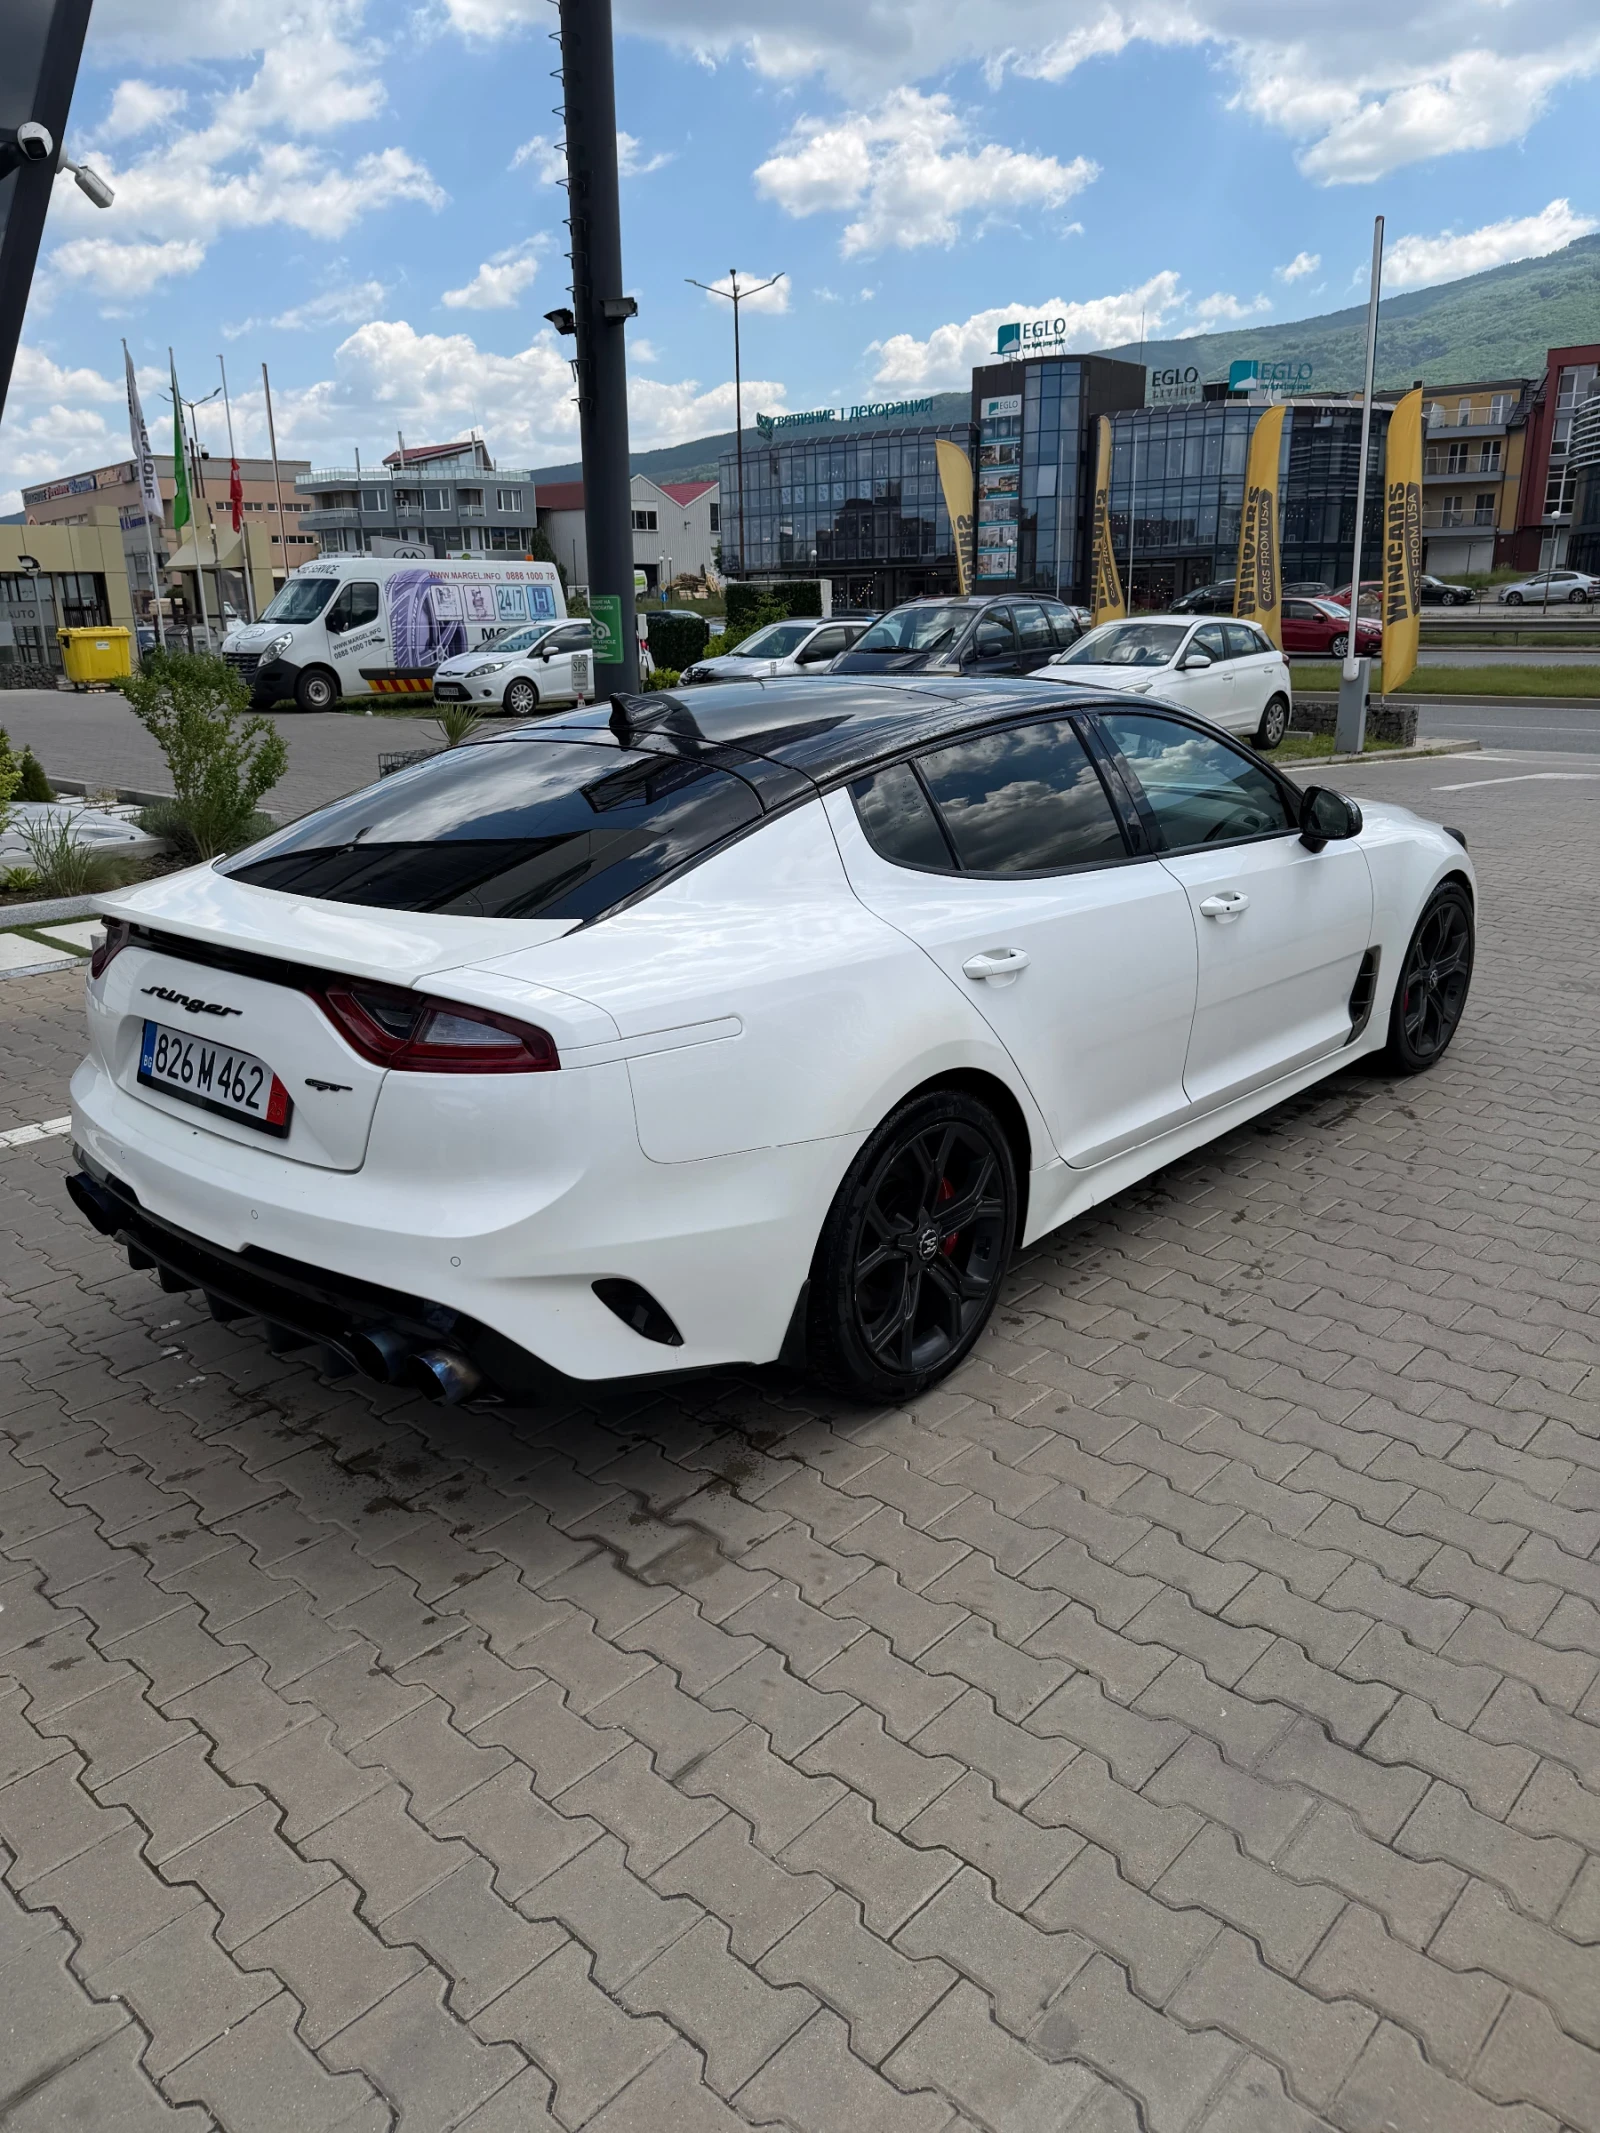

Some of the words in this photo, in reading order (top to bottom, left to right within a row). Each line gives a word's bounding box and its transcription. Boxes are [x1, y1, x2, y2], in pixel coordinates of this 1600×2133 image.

[1023, 318, 1066, 339] EGLO
[1152, 366, 1199, 387] EGLO
[1261, 362, 1313, 380] EGLO
[1000, 400, 1018, 409] EGLO
[1152, 385, 1197, 399] LIVING
[849, 397, 934, 423] декорация
[1260, 500, 1269, 526] USA
[1407, 492, 1418, 522] USA
[1237, 486, 1260, 618] WINCARS
[1260, 531, 1271, 567] FROM
[1387, 482, 1409, 626] WINCARS
[1409, 526, 1421, 567] FROM
[429, 571, 501, 580] WWW.MARGEL.INFO
[506, 571, 525, 580] 0888
[526, 572, 544, 580] 1000
[547, 572, 556, 580] 78
[1262, 569, 1272, 602] CARS
[333, 627, 382, 651] WWW.MARGEL.INFO
[334, 649, 349, 660] 0888
[349, 644, 364, 654] 1000
[572, 661, 587, 672] SPS
[140, 985, 243, 1016] stinger
[143, 1054, 153, 1069] BG
[155, 1033, 194, 1083] 826
[197, 1047, 216, 1093] M
[217, 1056, 265, 1110] 462
